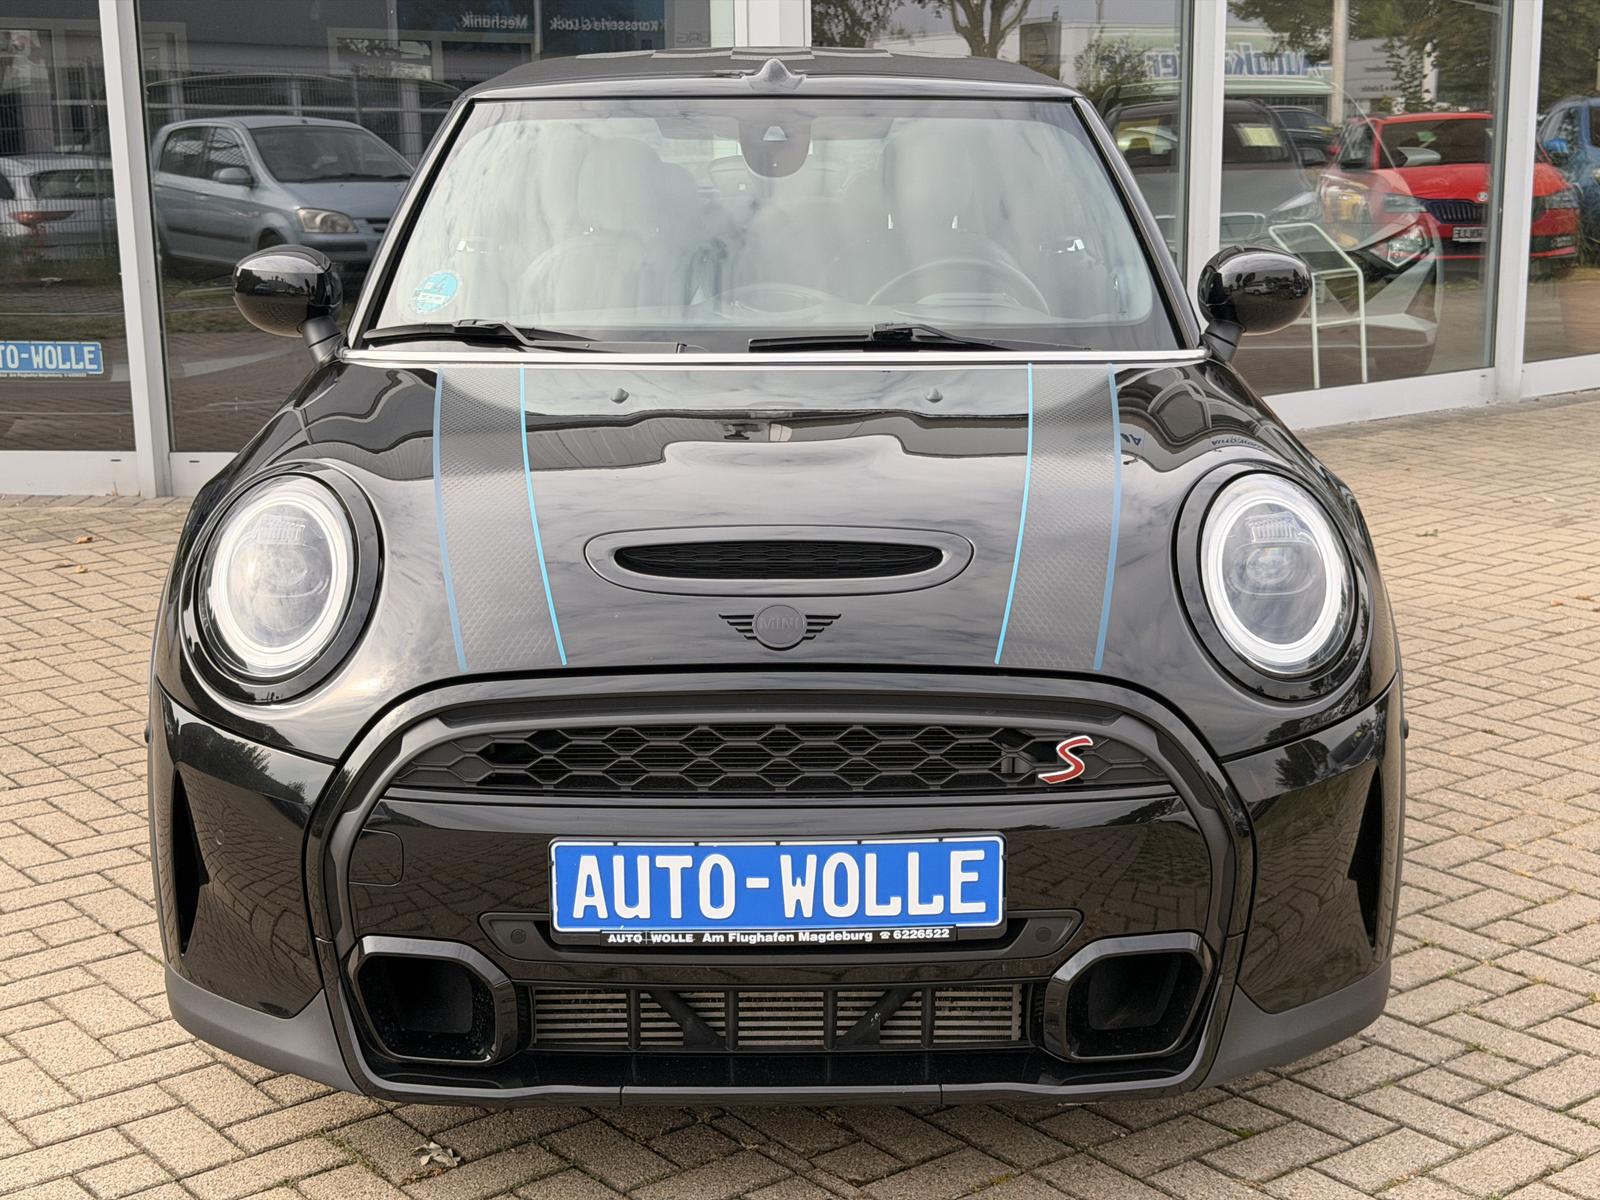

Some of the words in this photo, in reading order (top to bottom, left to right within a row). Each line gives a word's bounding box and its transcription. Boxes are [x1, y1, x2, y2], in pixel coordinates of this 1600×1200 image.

[757, 616, 800, 631] MINI
[1038, 735, 1093, 784] S
[572, 850, 987, 919] AUTO-WOLLE
[608, 933, 643, 943] AUTO
[651, 933, 694, 943] WOLLE
[702, 932, 725, 943] Am
[728, 931, 795, 944] Flughafen
[798, 930, 873, 943] Magdeburg
[892, 928, 950, 939] 6226522
